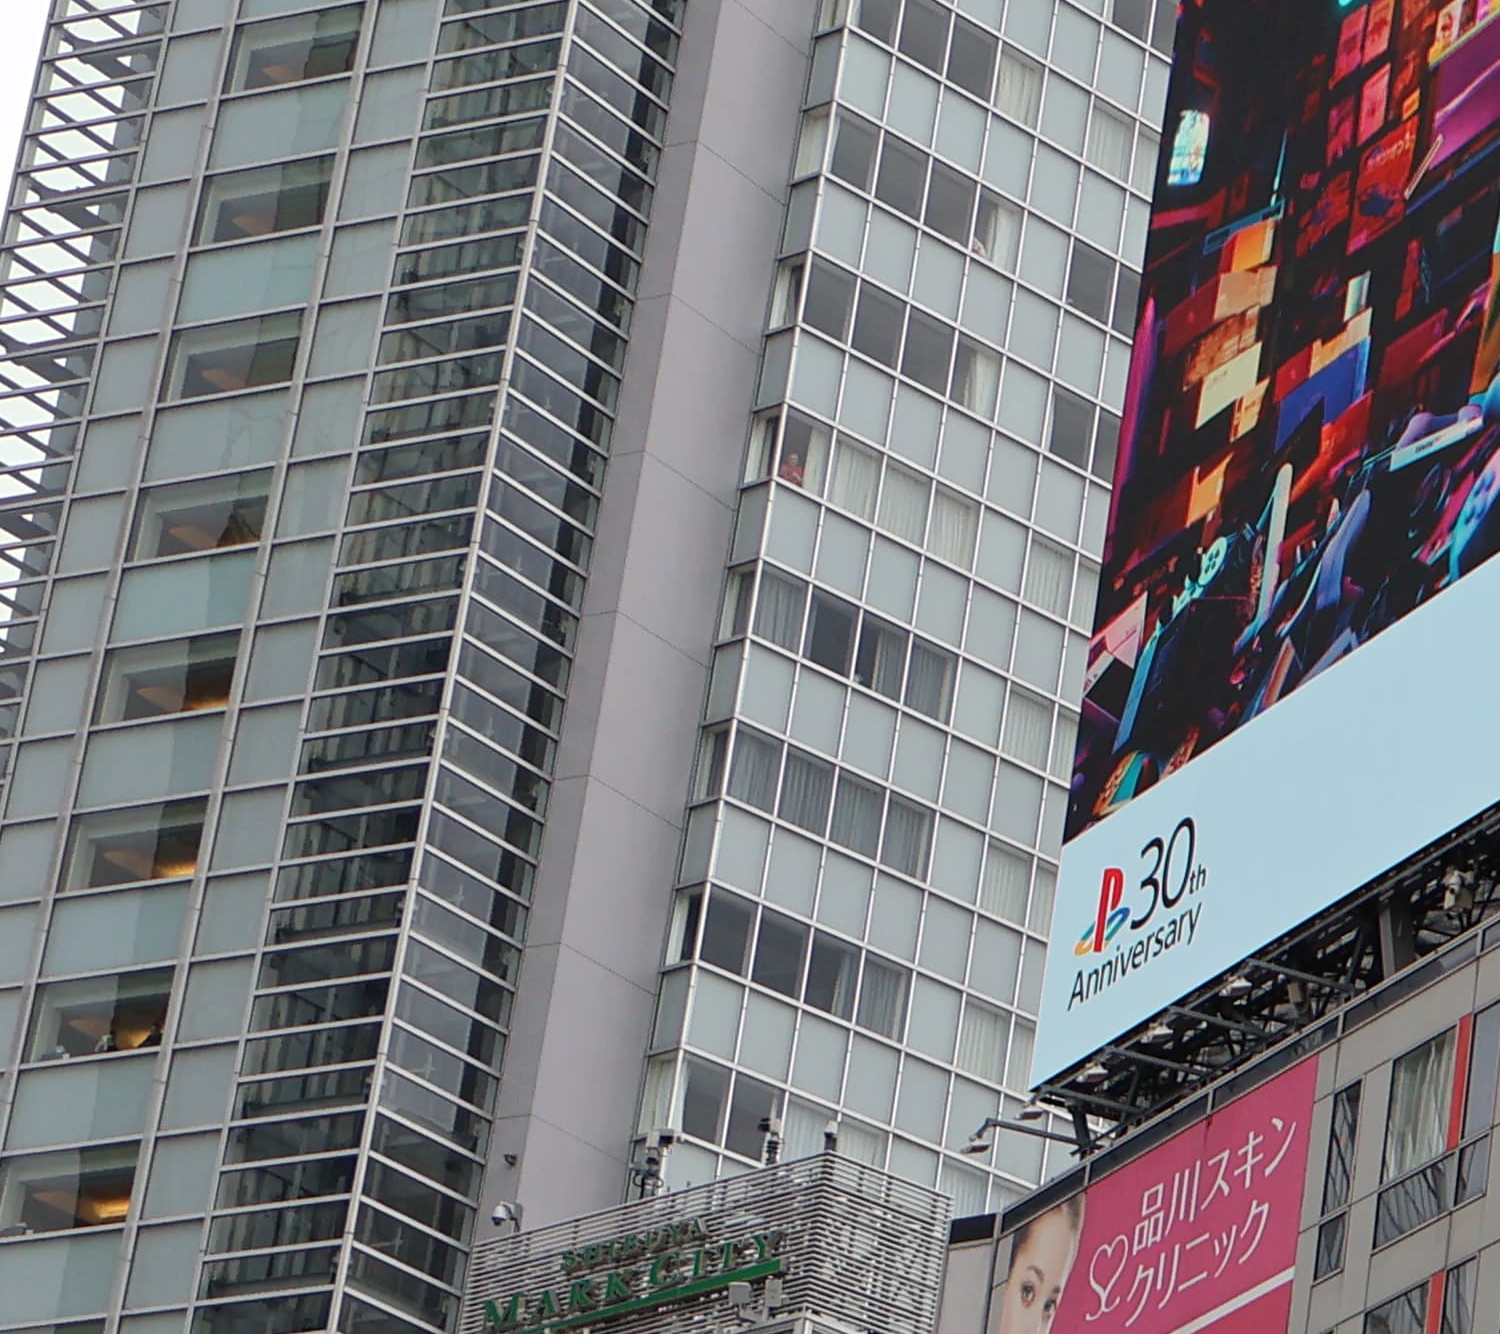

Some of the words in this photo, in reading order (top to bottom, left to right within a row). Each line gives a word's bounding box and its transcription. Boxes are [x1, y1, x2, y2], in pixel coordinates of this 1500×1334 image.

[1067, 902, 1202, 1011] Anniversary
[1132, 1117, 1297, 1256] 品川スキン
[561, 1219, 707, 1269] SHIBUYA
[648, 1230, 781, 1287] CITY
[1125, 1199, 1269, 1328] クリニック
